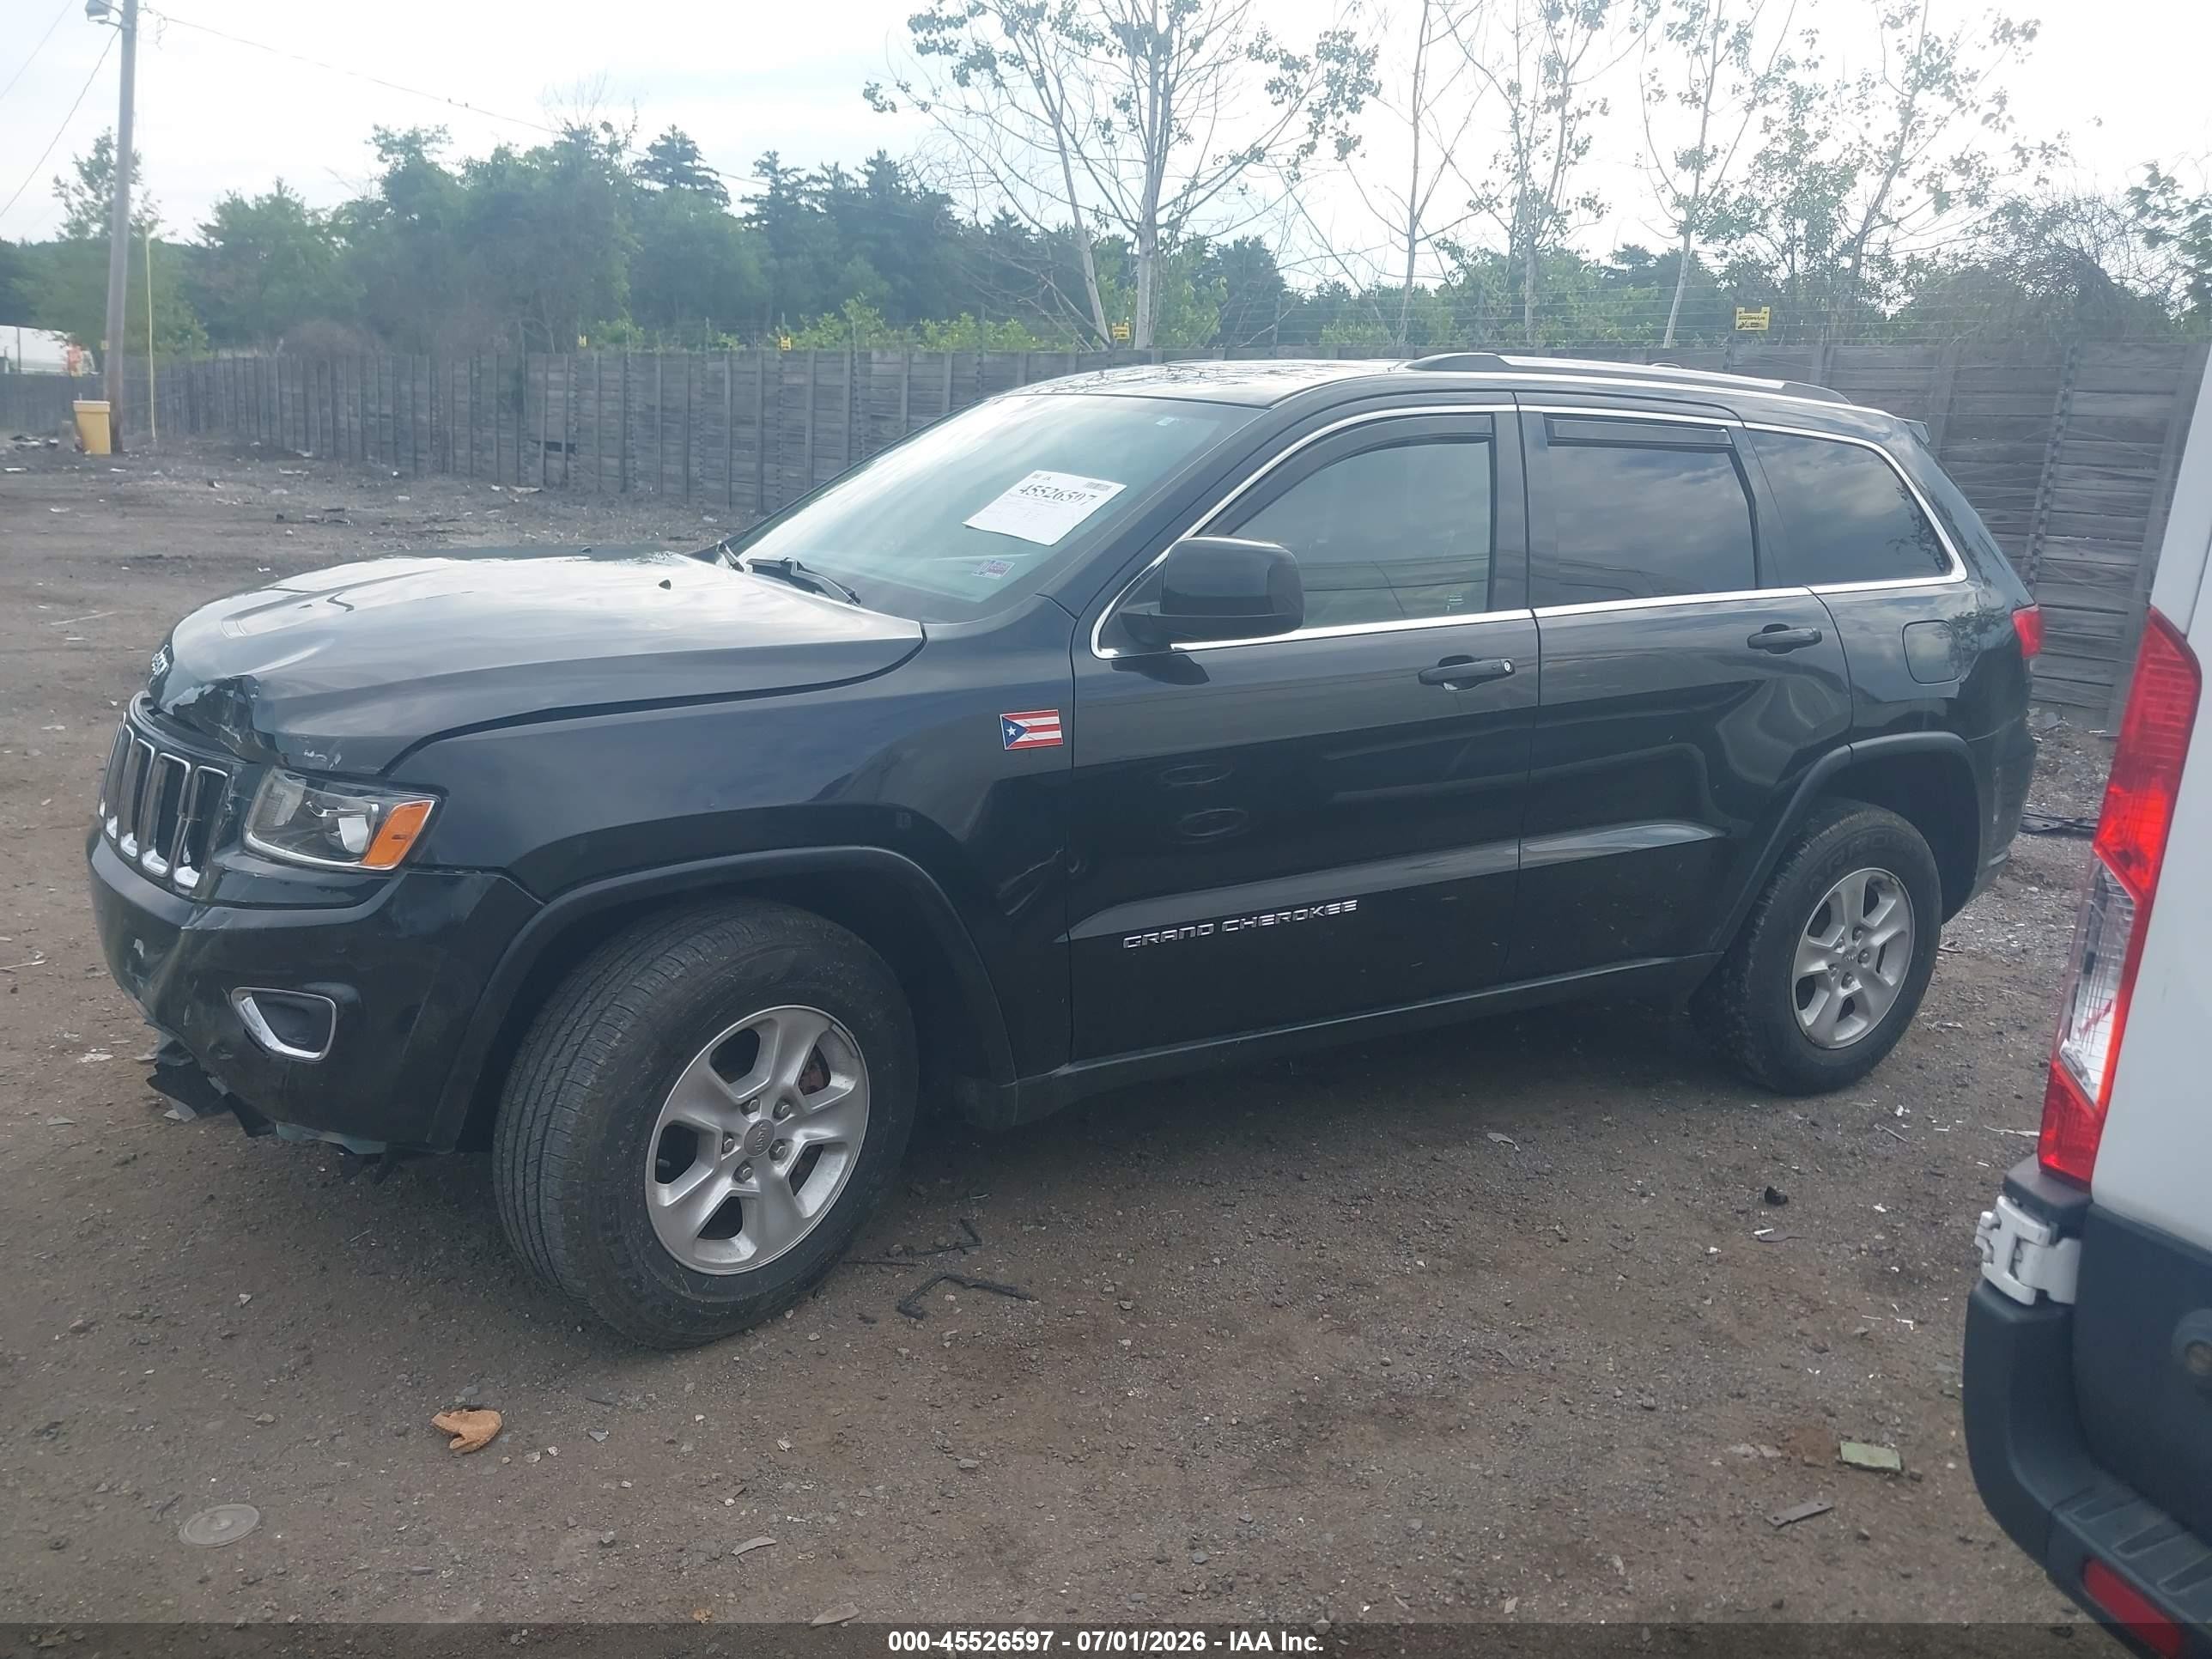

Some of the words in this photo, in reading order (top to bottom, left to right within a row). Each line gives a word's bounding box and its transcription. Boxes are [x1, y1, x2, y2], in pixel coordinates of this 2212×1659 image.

[1019, 483, 1098, 507] 45526597
[1123, 923, 1214, 949] GRAND
[1222, 900, 1358, 932] CHEROKEE
